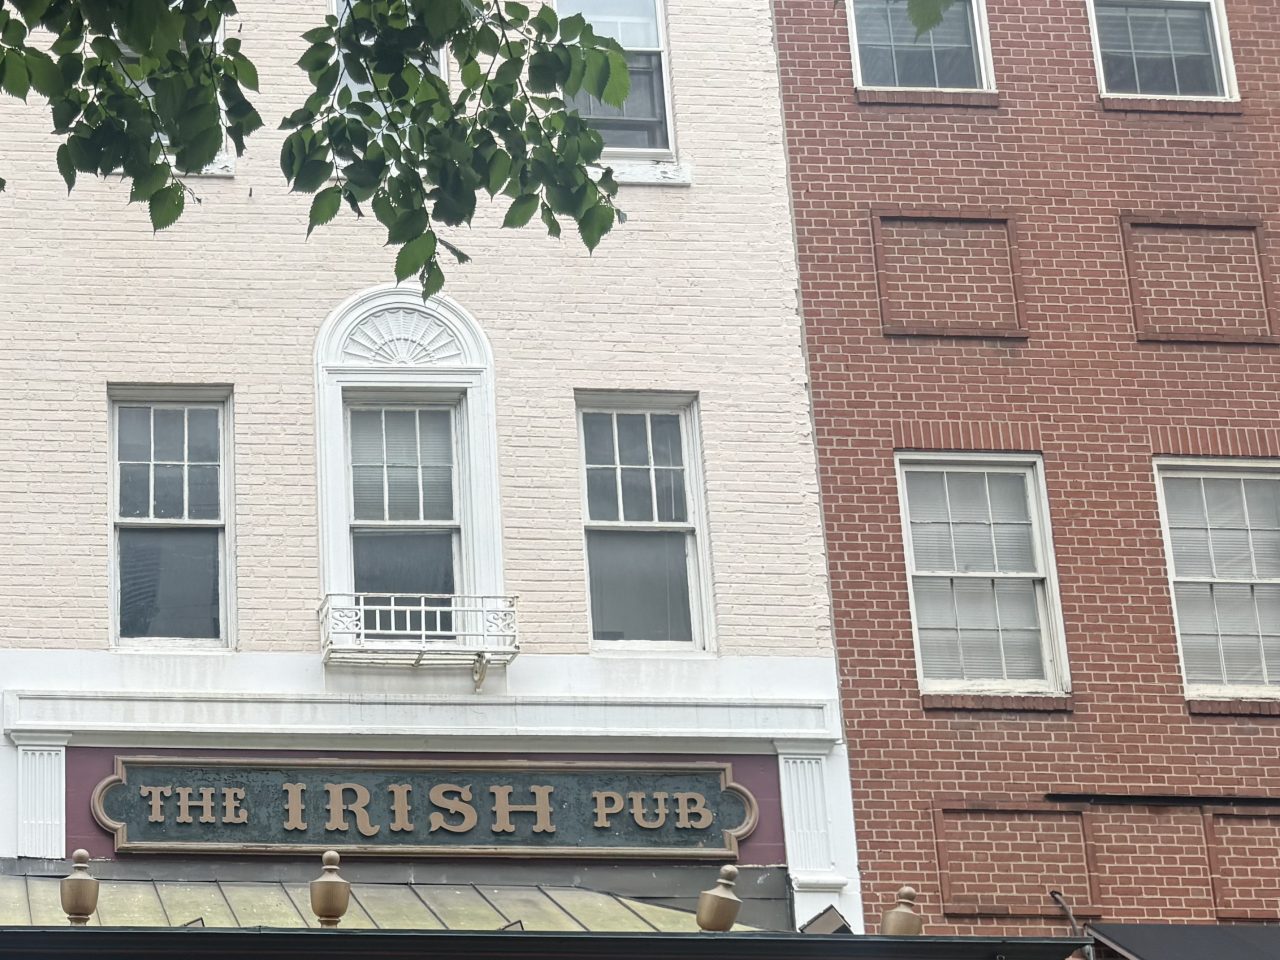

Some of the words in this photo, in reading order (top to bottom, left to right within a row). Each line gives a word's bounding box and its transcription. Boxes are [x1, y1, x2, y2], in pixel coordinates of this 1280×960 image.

[138, 784, 249, 824] THE
[282, 781, 557, 836] IRISH
[592, 790, 714, 830] PUB
